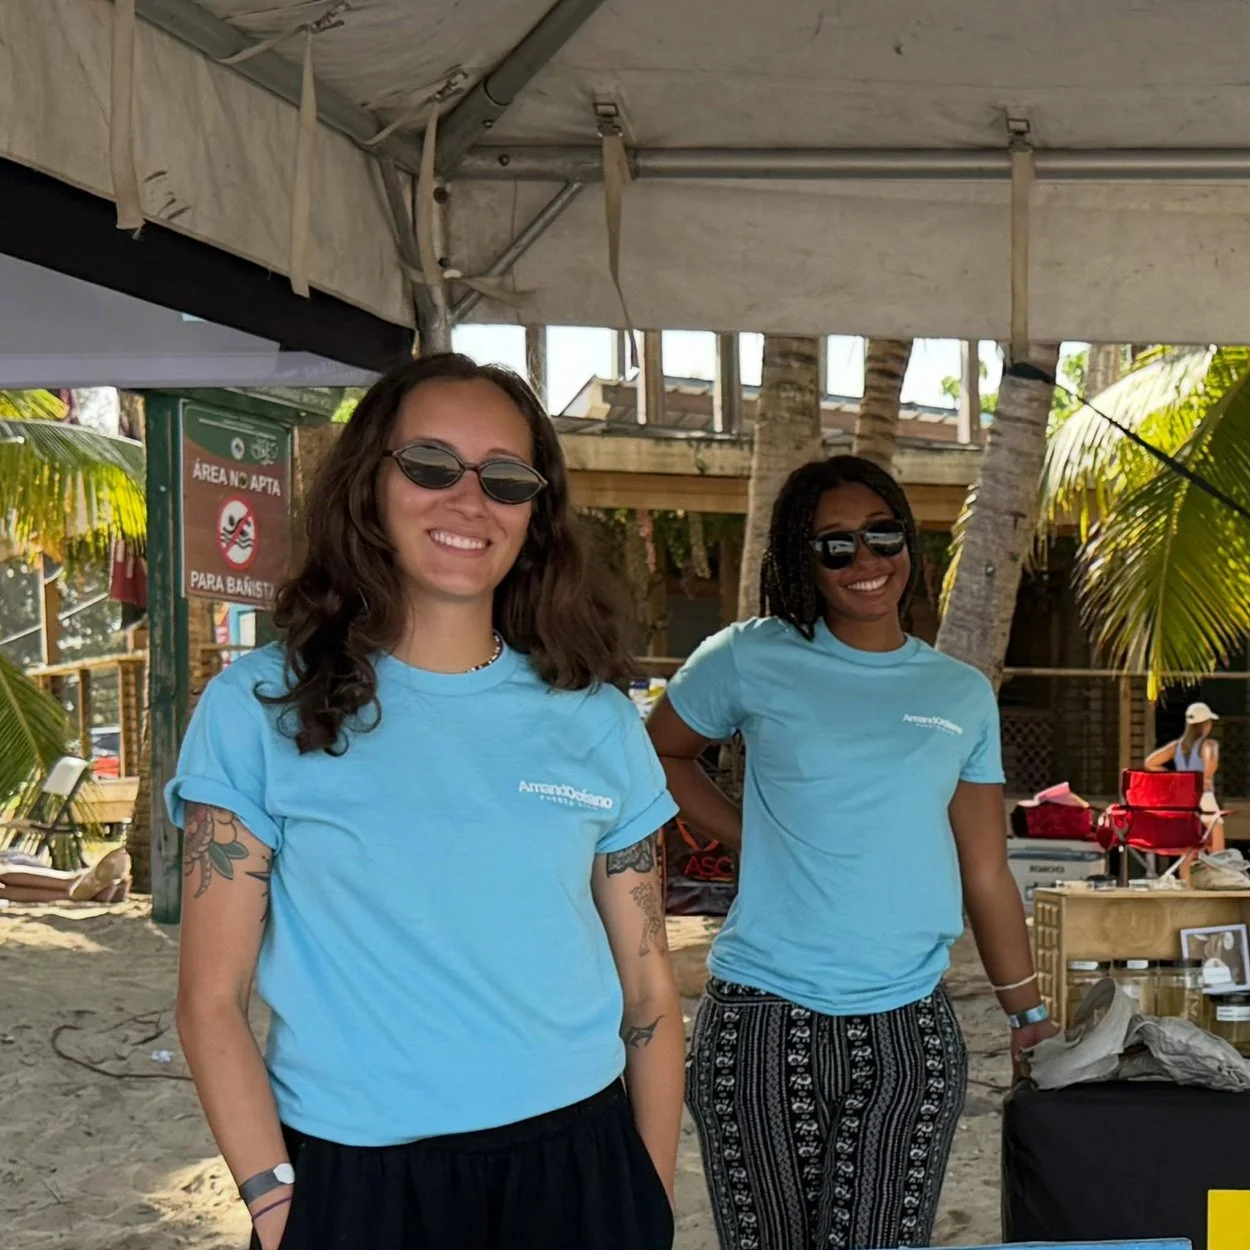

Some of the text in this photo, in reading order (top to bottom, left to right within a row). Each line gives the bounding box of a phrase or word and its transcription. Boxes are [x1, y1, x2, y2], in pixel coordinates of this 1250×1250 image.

[192, 459, 281, 496] ÁREA NO APTA
[190, 570, 224, 594] PARA
